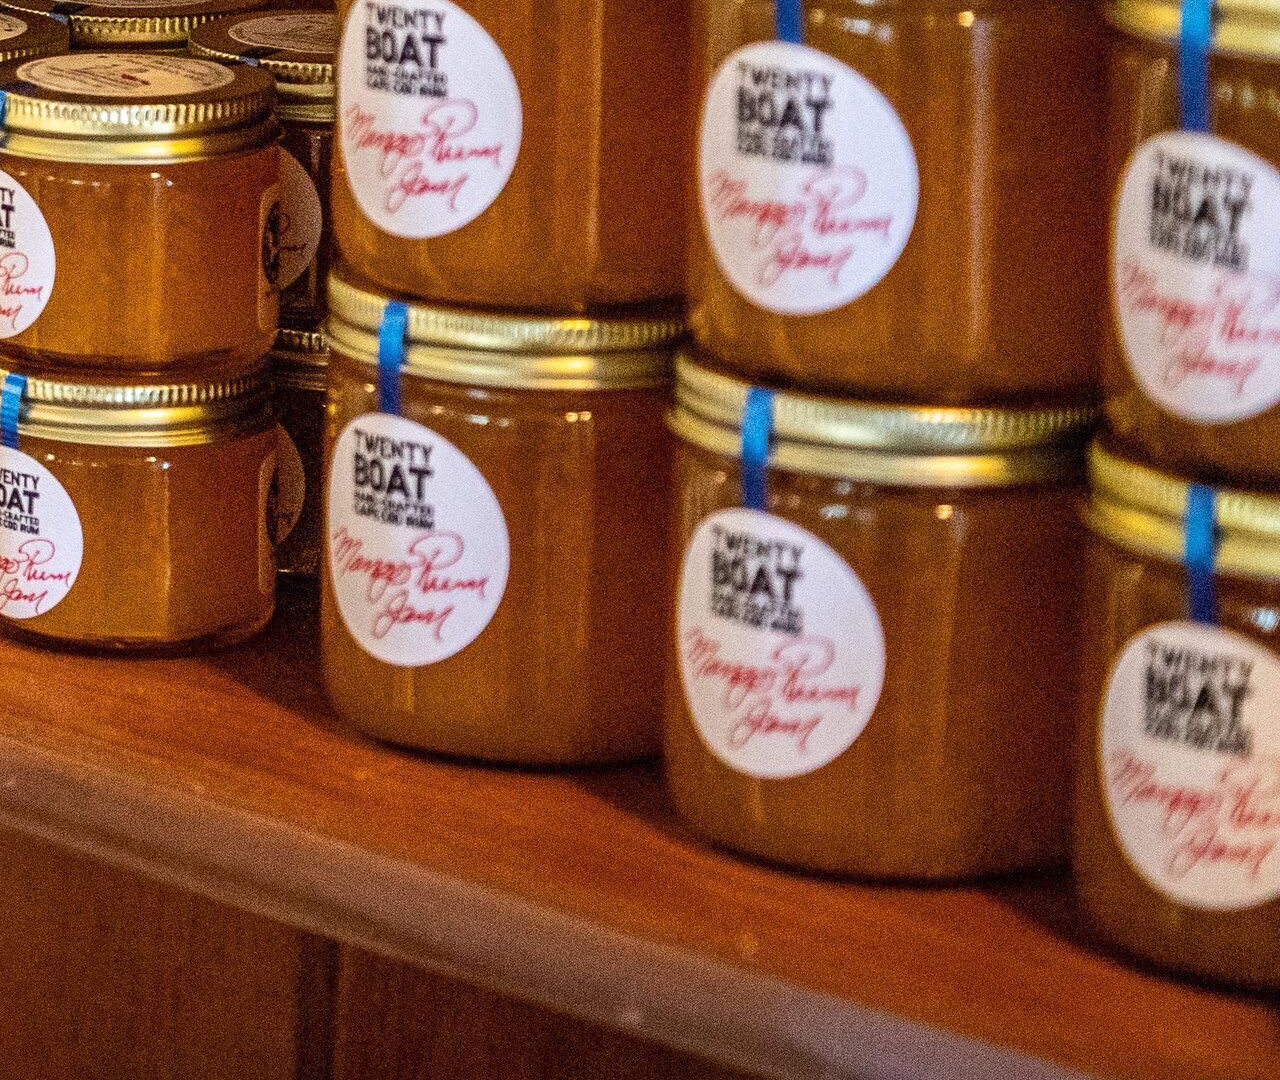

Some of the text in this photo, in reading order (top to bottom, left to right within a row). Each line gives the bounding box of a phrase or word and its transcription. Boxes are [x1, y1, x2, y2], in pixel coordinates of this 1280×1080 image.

[365, 0, 447, 33] TWENTY
[366, 26, 446, 69] BOAT
[738, 85, 833, 133] BOAT
[353, 428, 434, 464] TWENTY
[354, 453, 434, 500] BOAT
[20, 522, 39, 535] RUM
[18, 539, 71, 588] Rum
[712, 550, 801, 601] BOAT
[371, 589, 455, 641] Jam
